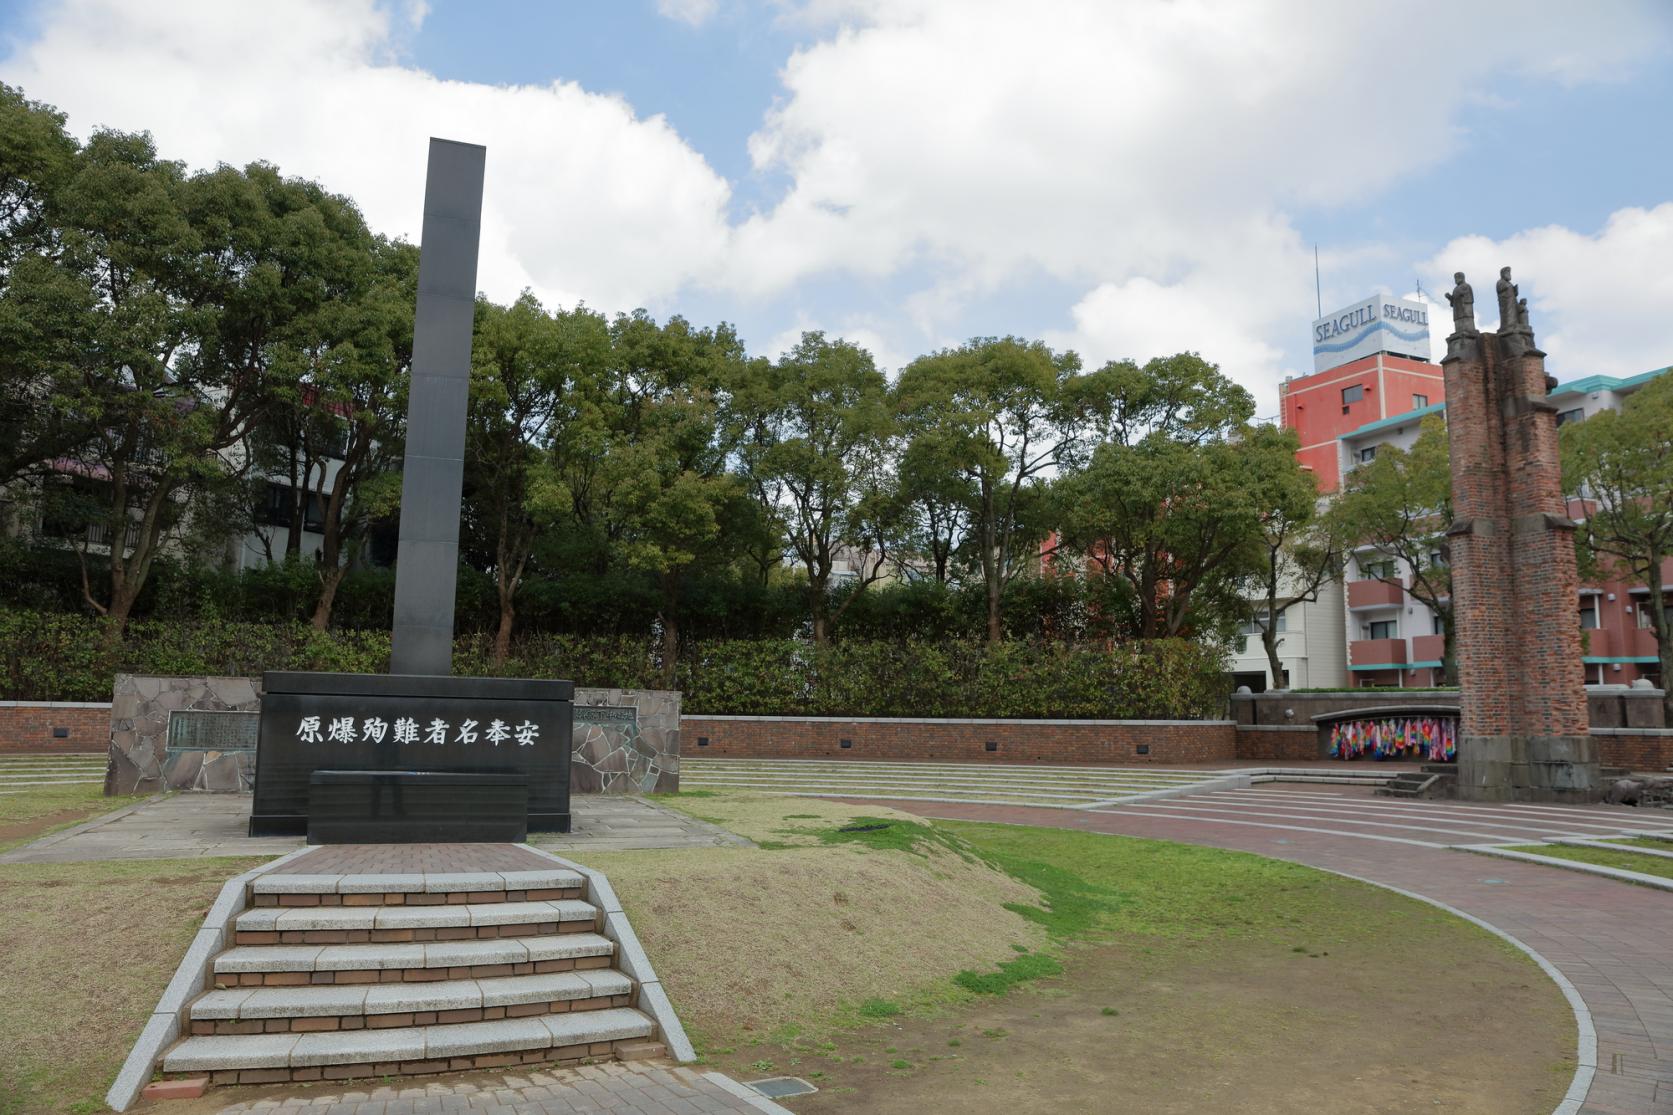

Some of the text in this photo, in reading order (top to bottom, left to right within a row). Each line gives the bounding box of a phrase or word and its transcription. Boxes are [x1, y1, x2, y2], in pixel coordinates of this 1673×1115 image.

[1316, 305, 1376, 342] SEAGULL
[1384, 304, 1428, 325] SEAGULL
[296, 716, 540, 746] 原爆殉難者名奉安
